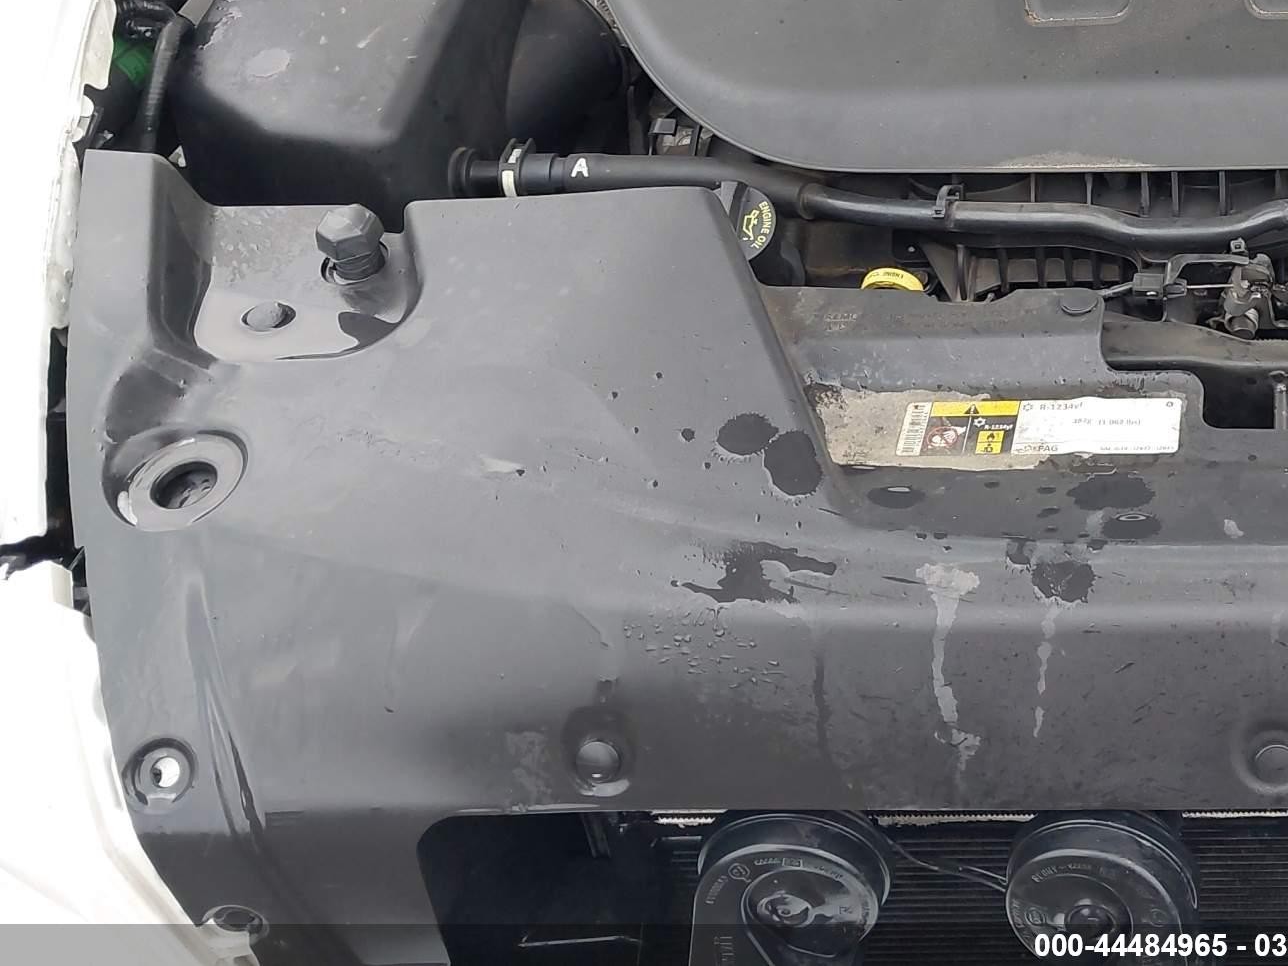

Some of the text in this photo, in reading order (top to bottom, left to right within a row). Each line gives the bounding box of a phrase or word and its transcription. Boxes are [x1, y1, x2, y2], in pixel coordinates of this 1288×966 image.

[571, 157, 589, 178] A
[750, 200, 772, 249] ENGINE OIL
